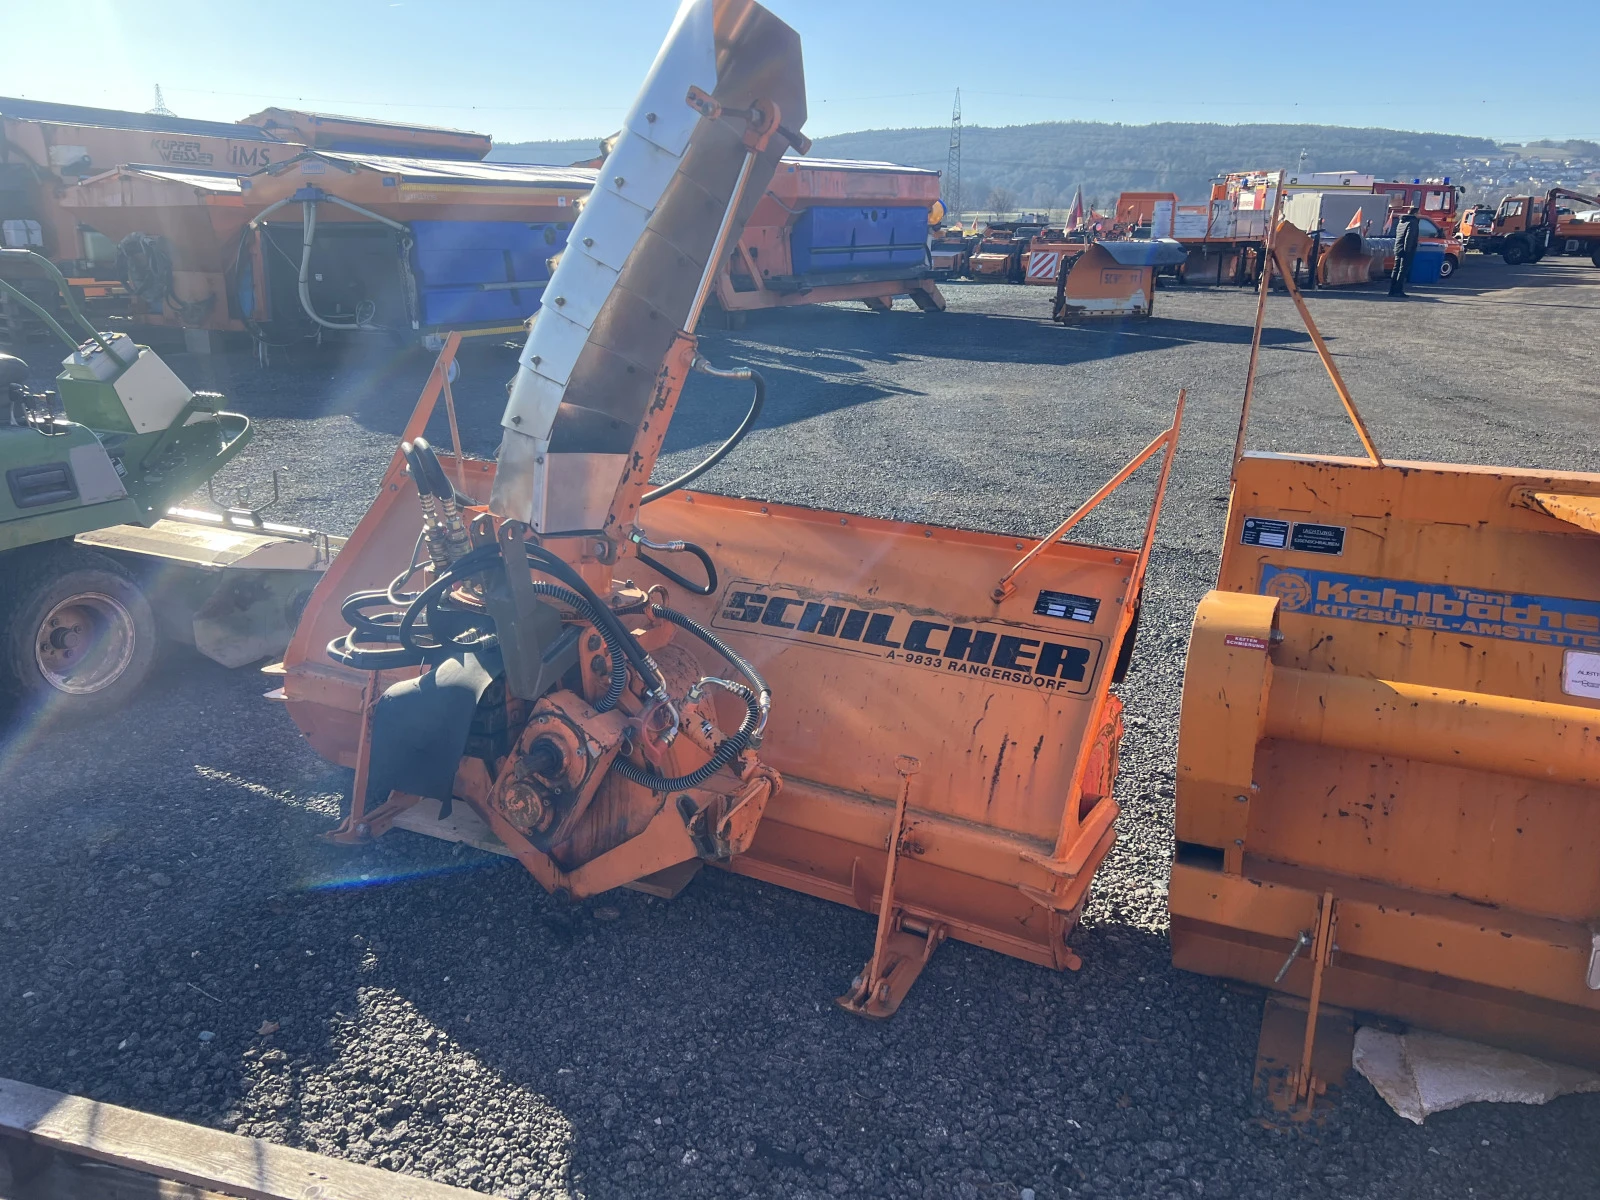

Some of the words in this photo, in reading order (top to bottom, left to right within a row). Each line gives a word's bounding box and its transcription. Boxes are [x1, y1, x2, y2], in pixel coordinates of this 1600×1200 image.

[1456, 589, 1512, 606] Toni
[722, 591, 1091, 682] SCHILCHER
[1226, 640, 1265, 649] SCHMIERUNG
[886, 650, 942, 668] A-9833
[947, 661, 1067, 691] RANGERSDORF
